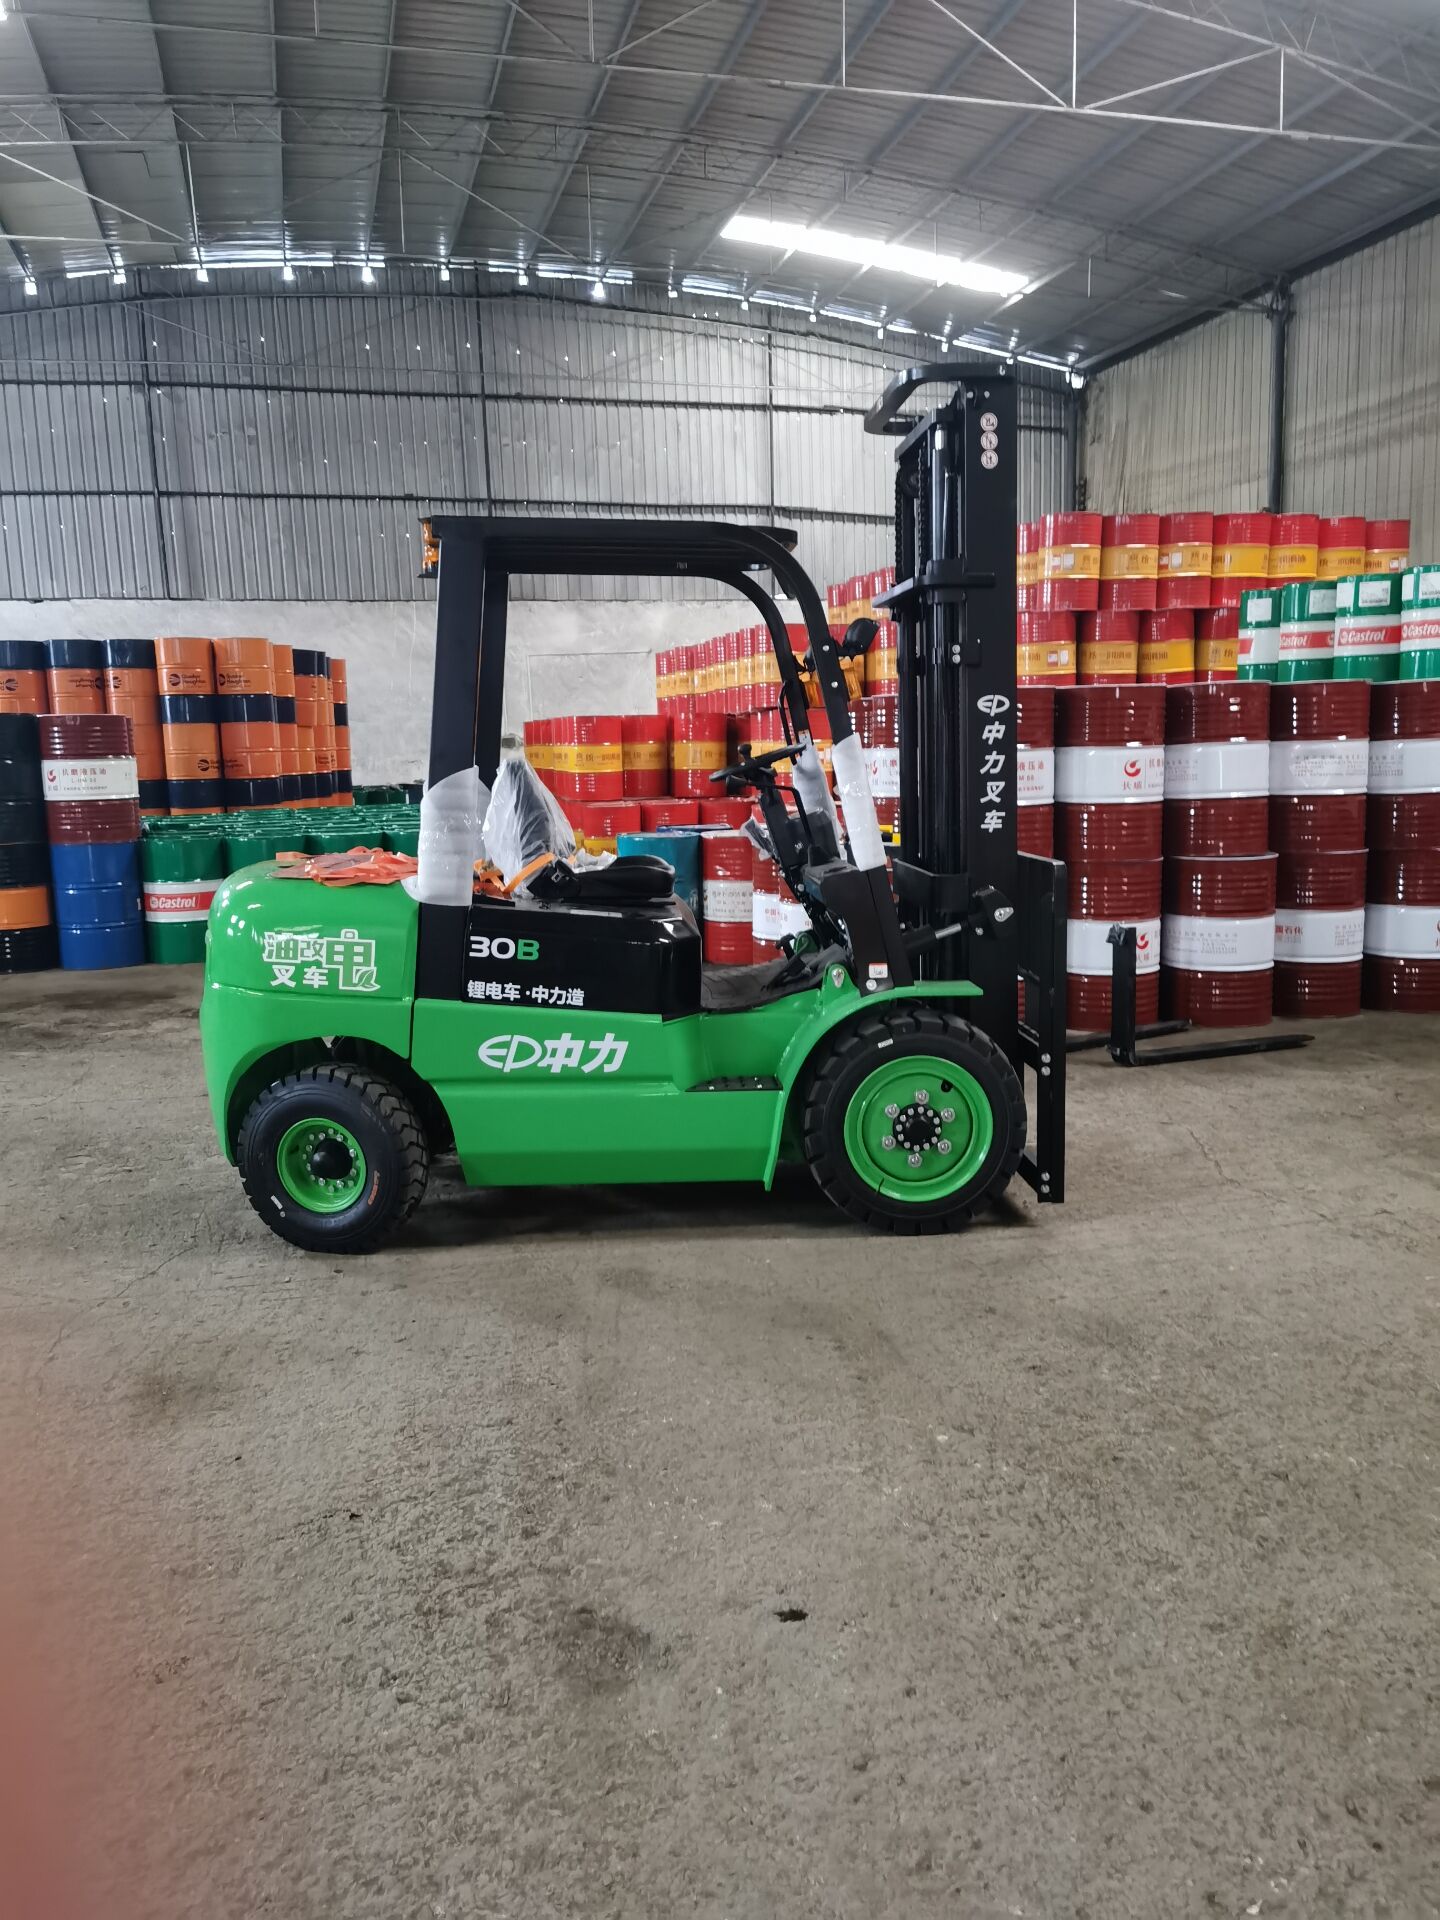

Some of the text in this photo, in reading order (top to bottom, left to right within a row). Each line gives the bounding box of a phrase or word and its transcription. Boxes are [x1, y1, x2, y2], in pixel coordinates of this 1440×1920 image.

[1348, 630, 1385, 643] Castrol
[979, 721, 1006, 833] 中力叉车
[159, 896, 196, 909] Castrol
[469, 935, 540, 961] 30B
[270, 965, 328, 988] 叉车
[537, 1032, 629, 1073] 中力
